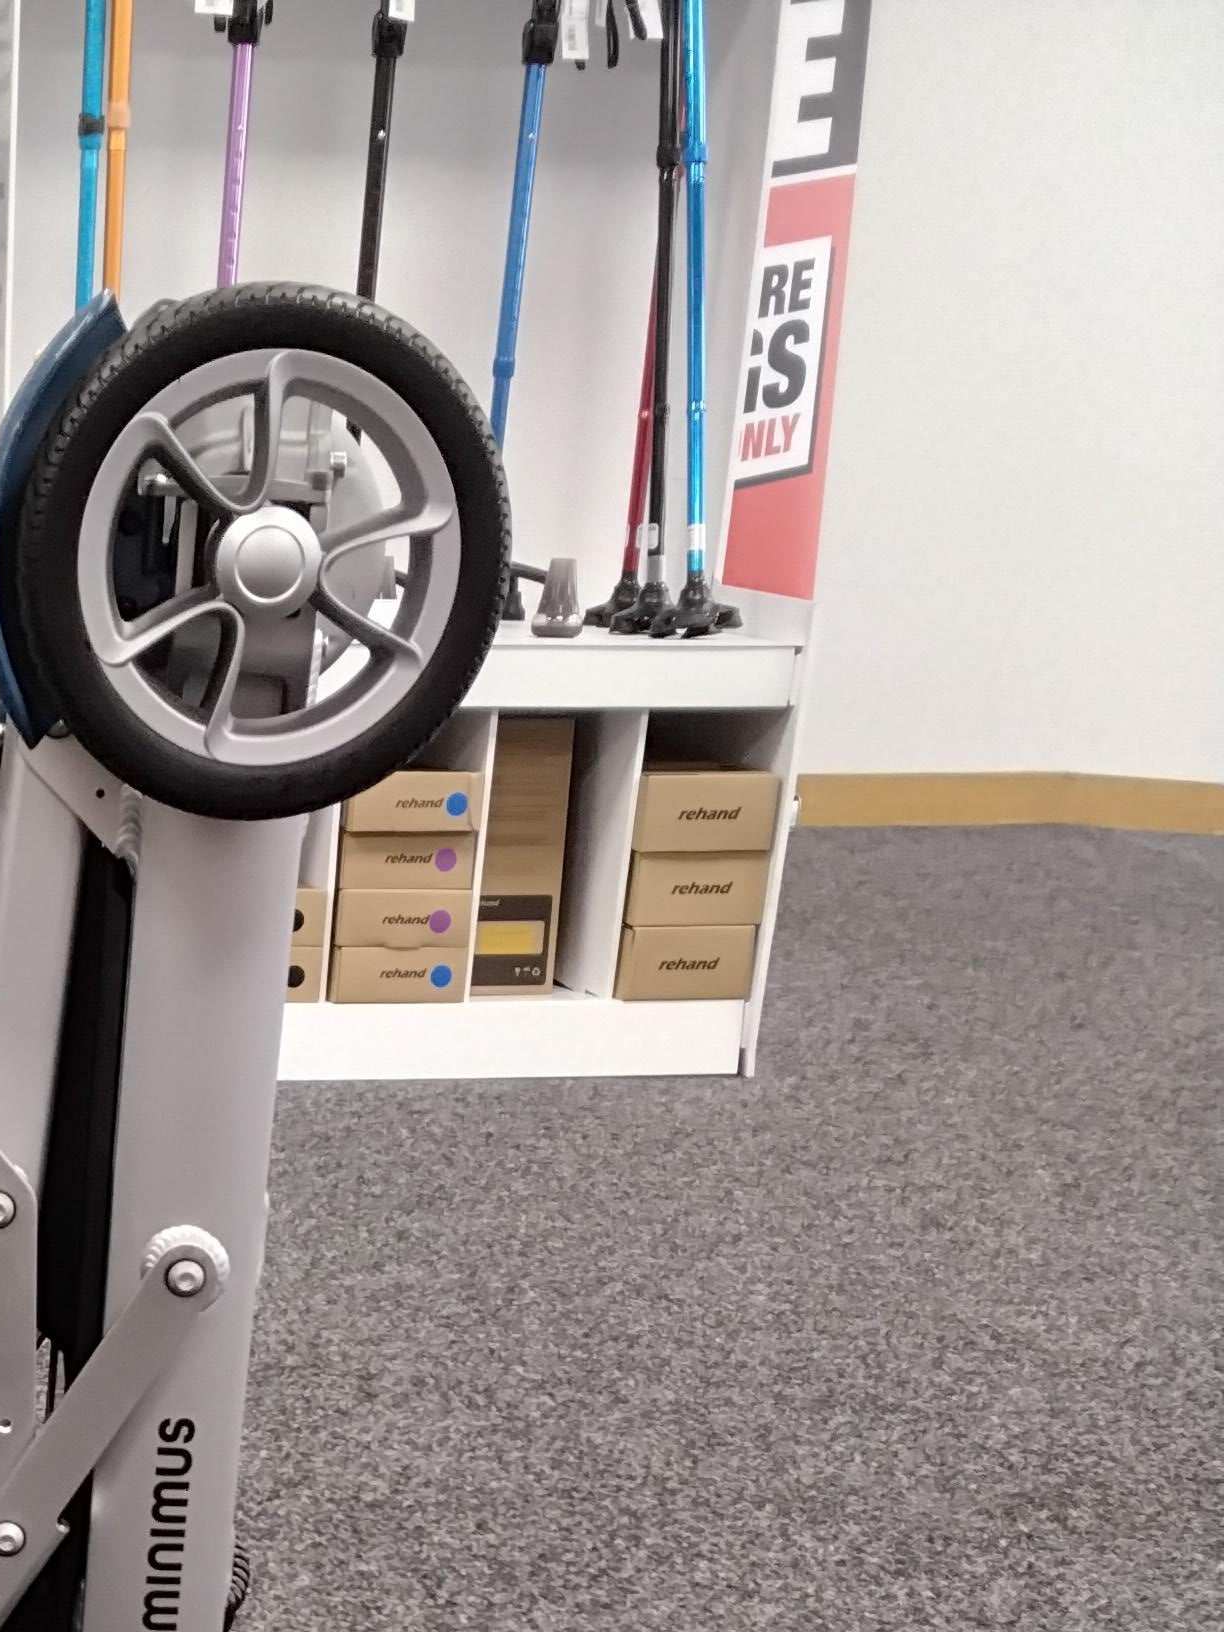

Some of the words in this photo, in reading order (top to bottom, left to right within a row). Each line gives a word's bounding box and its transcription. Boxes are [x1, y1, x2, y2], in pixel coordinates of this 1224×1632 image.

[738, 413, 801, 463] NLY
[395, 797, 445, 809] rehand
[678, 806, 742, 821] rehand
[385, 853, 433, 864] rehand
[671, 881, 734, 895] rehand
[382, 914, 431, 926] rehand
[658, 957, 720, 971] rehand
[379, 967, 426, 979] rehand
[142, 1417, 196, 1632] minimus
